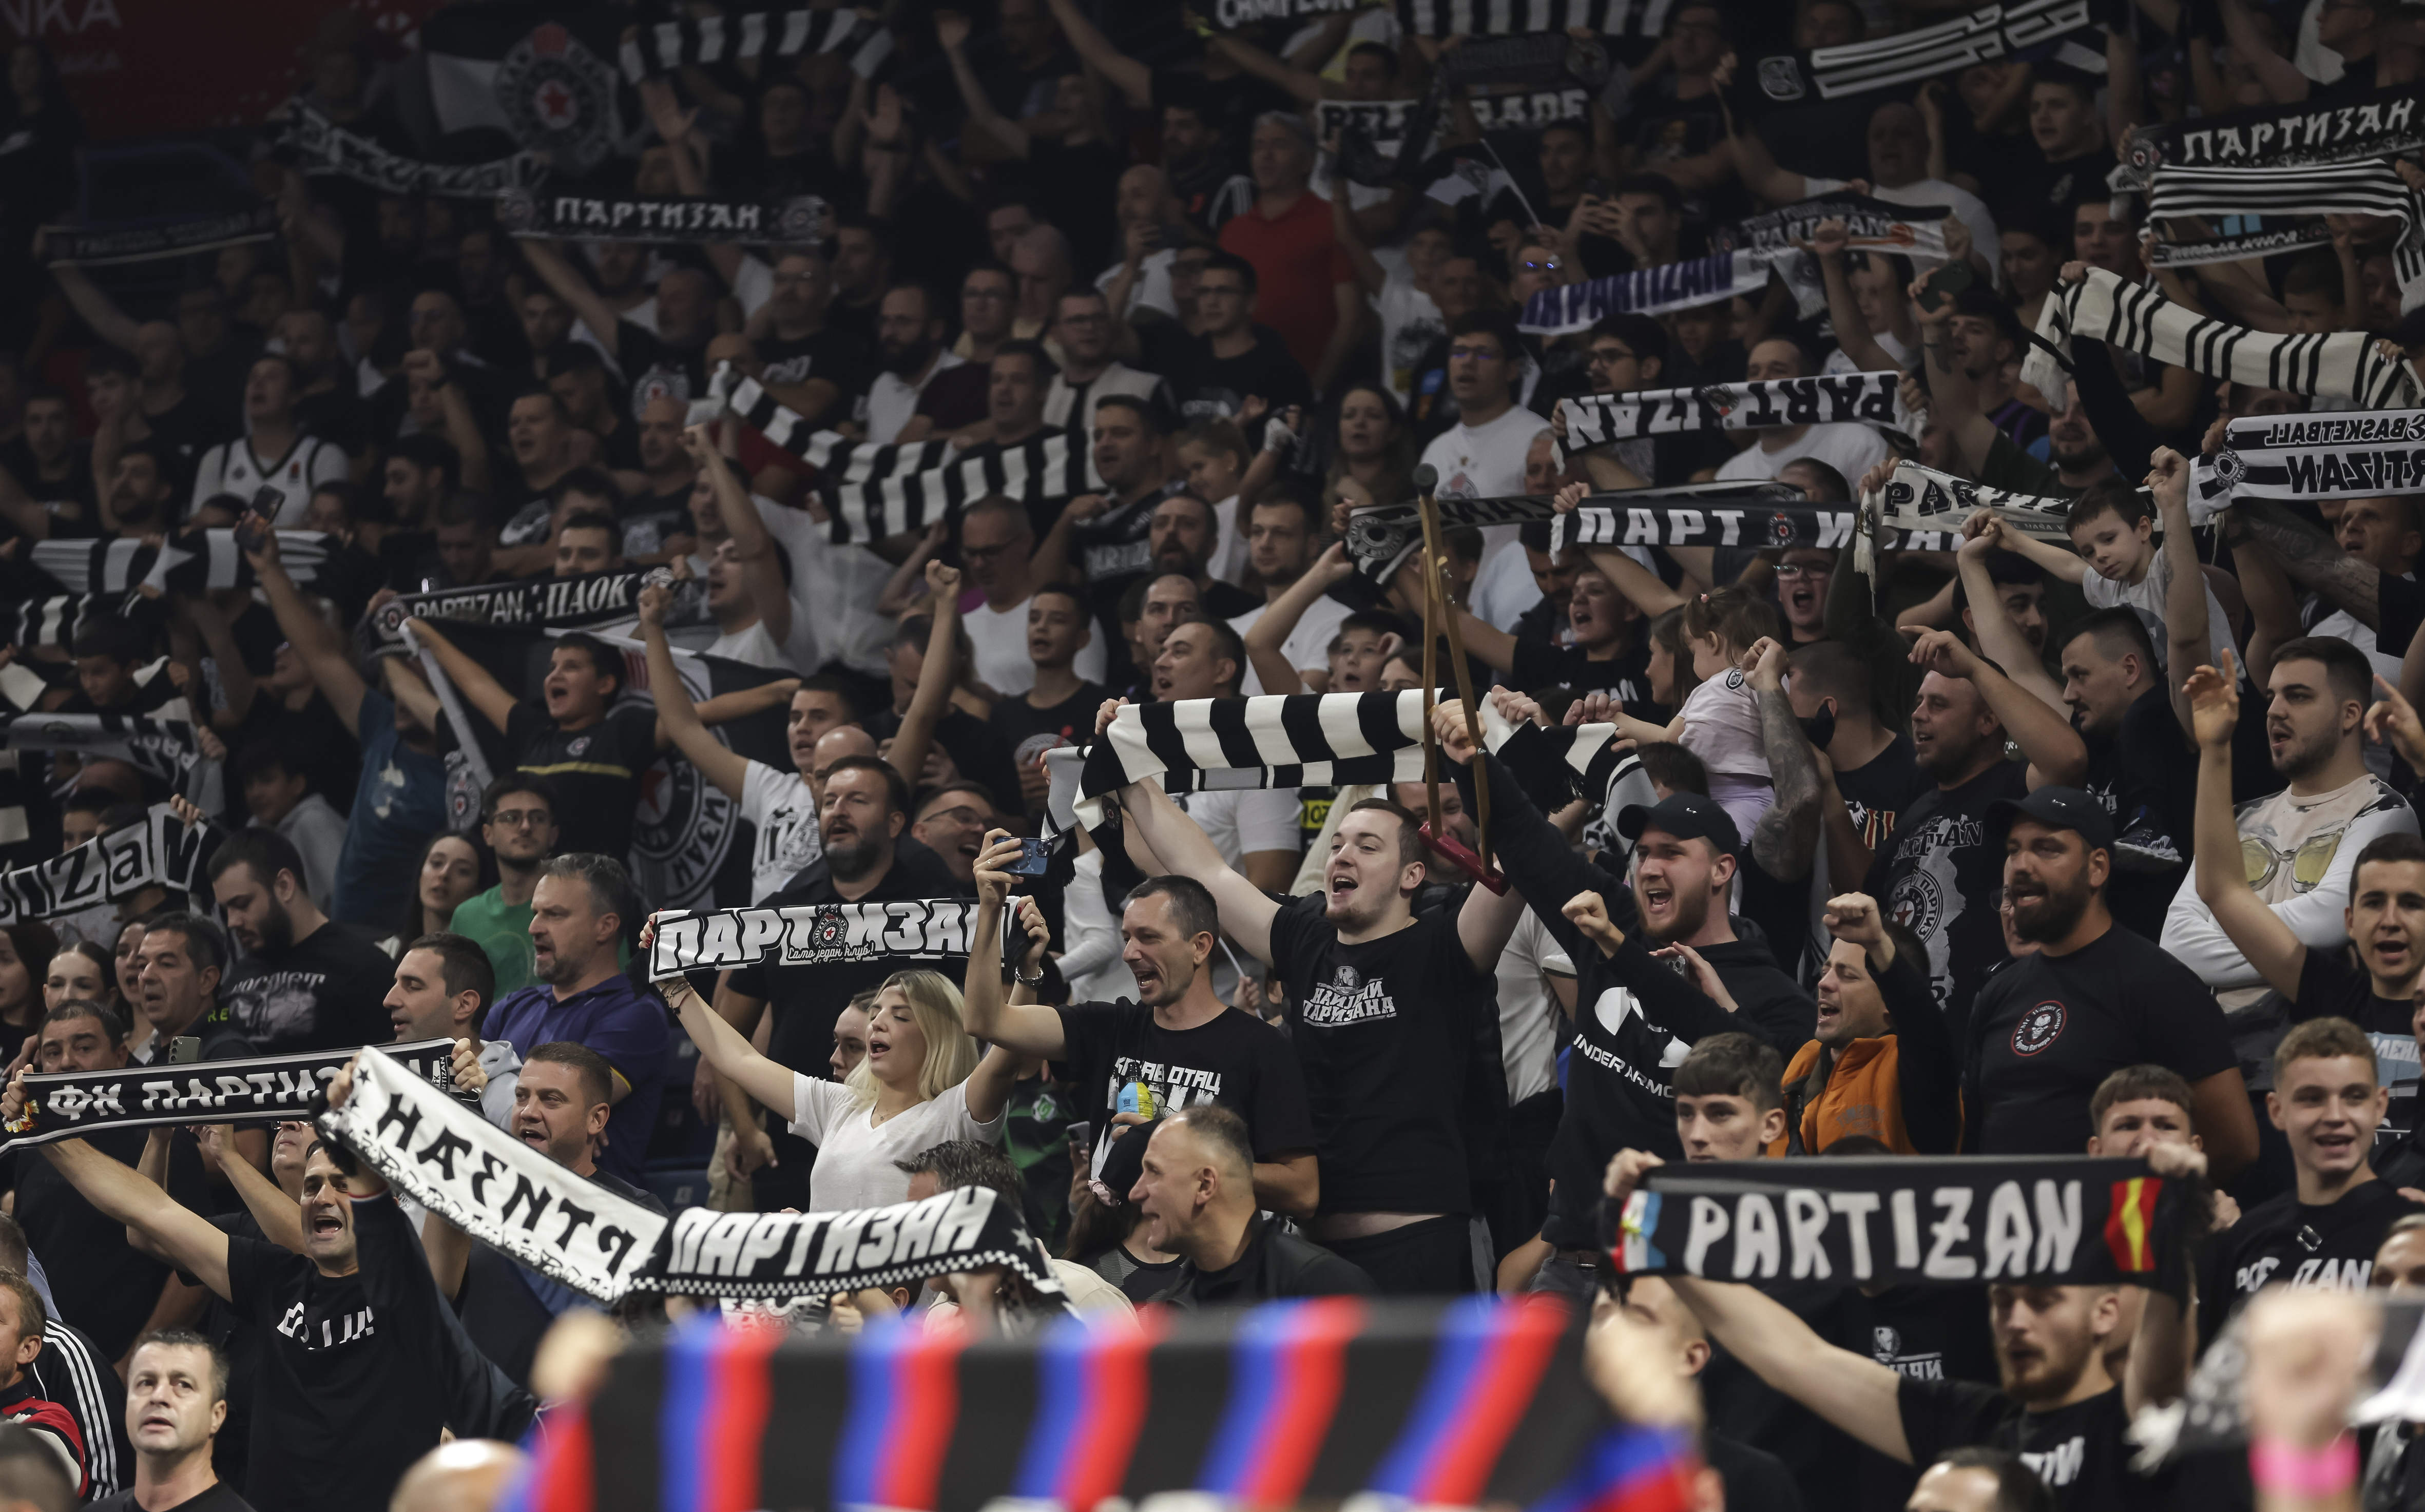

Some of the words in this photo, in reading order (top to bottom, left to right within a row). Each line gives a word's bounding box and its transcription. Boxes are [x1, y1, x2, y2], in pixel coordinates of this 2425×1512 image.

[2182, 95, 2416, 165] ПАРТИЗАН
[554, 196, 762, 230] ПАРТИЗАН
[48, 1084, 126, 1120] ФК
[1167, 1065, 1221, 1095] ОТАЦ
[667, 1185, 998, 1278] ПАРТИЗАН
[1683, 1179, 2083, 1280] PARTIZAN
